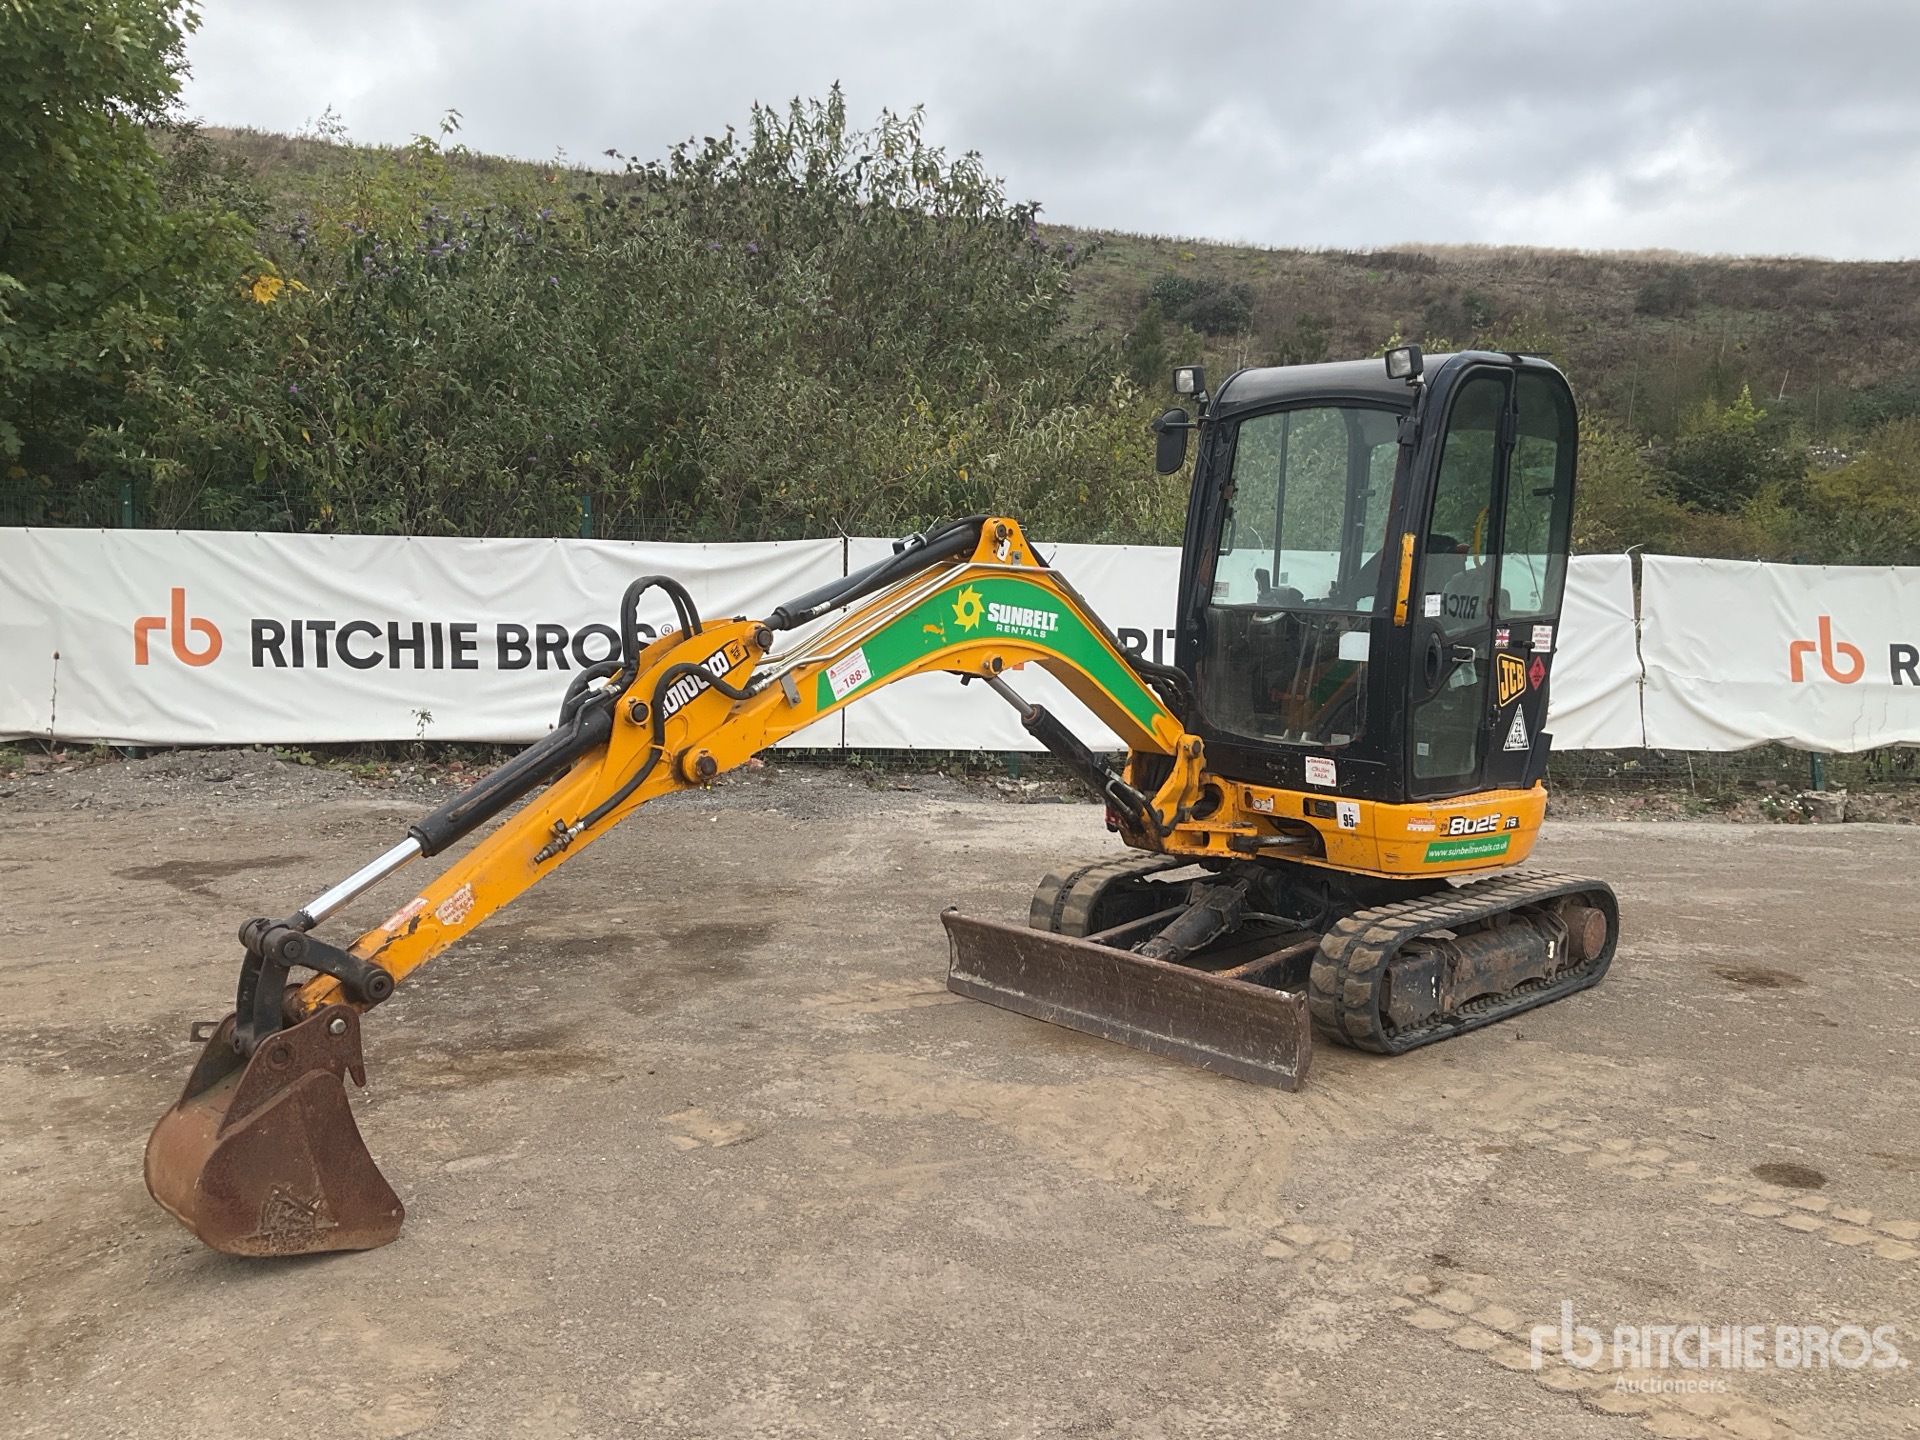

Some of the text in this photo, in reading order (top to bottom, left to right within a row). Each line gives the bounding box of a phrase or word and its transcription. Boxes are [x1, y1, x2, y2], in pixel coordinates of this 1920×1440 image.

[133, 588, 223, 667] rb
[987, 602, 1058, 631] SUNBELT
[995, 623, 1046, 638] RENTALS
[251, 619, 478, 670] RITCHIE
[1117, 628, 1175, 665] RI
[1790, 616, 1865, 684] rb
[843, 669, 862, 688] 188
[1501, 660, 1524, 701] JCB
[1343, 814, 1355, 827] 95
[1428, 841, 1508, 857] www.sunbeltrentals.co.uk
[454, 891, 467, 903] NOT
